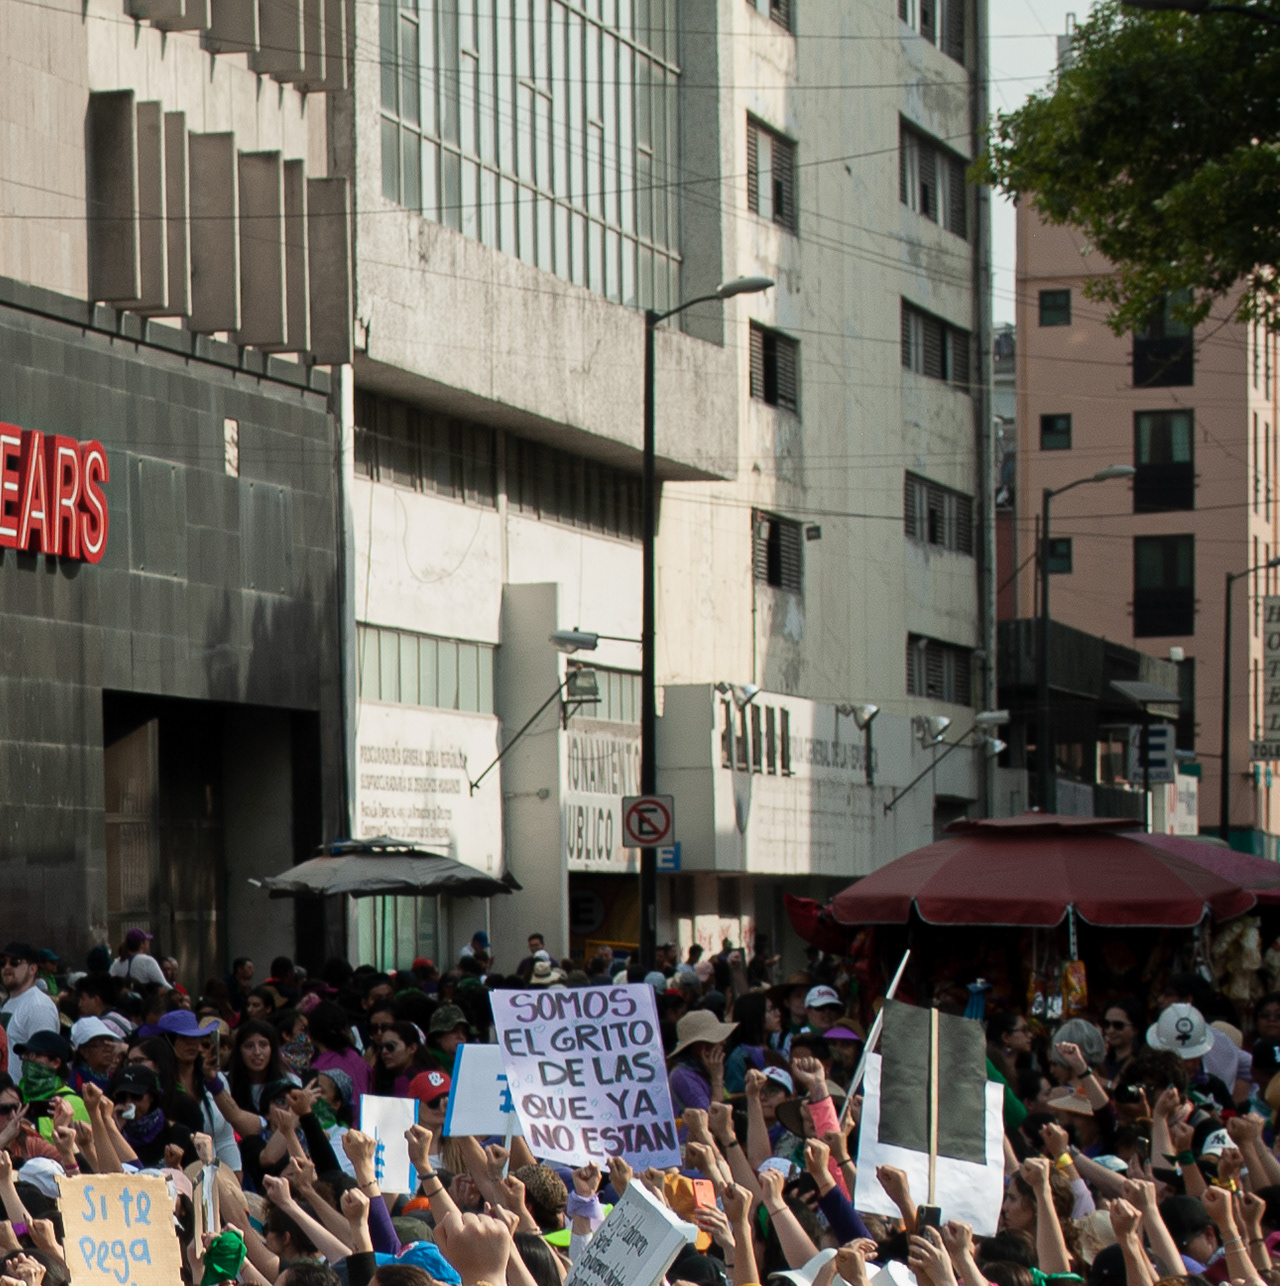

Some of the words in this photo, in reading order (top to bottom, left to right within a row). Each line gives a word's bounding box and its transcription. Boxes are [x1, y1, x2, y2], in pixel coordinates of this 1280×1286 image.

[509, 988, 638, 1024] SOMOS
[503, 1027, 546, 1058] EL
[550, 1019, 655, 1053] GRITO
[538, 1057, 586, 1087] DE
[591, 1051, 657, 1086] LAS
[521, 1092, 595, 1122] QUE
[605, 1087, 659, 1121] YA
[528, 1123, 577, 1152] NO
[580, 1120, 678, 1158] ESTAN
[118, 1186, 152, 1229] te
